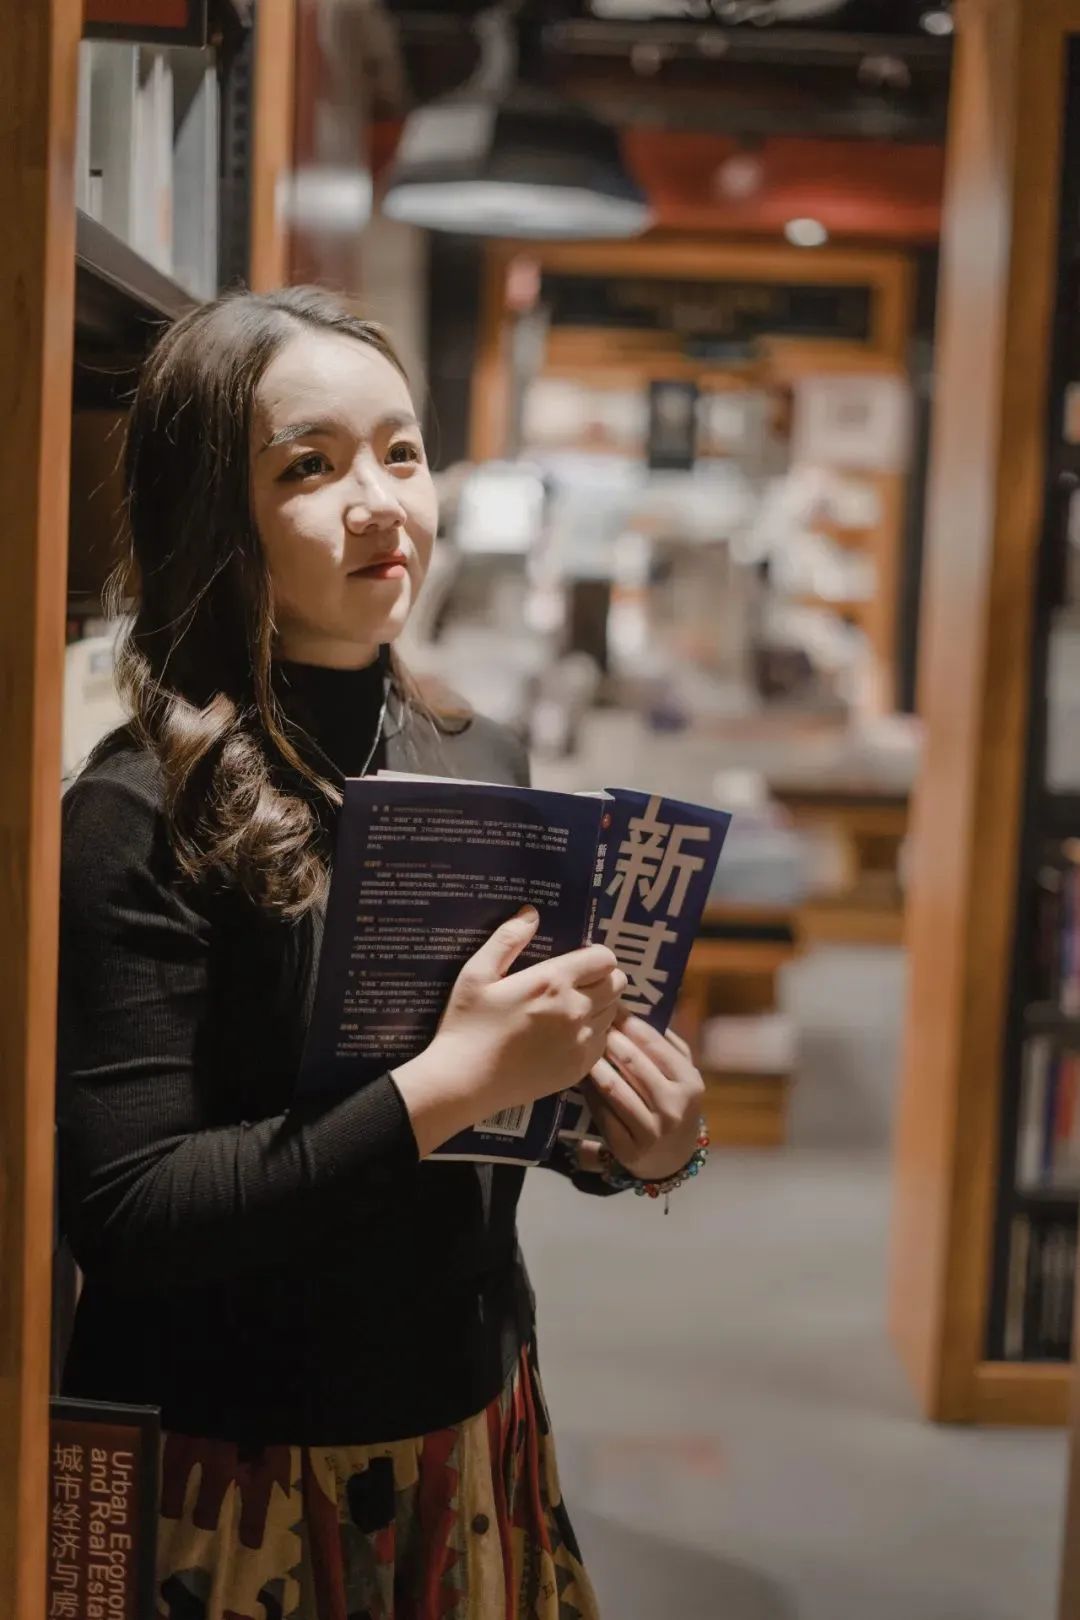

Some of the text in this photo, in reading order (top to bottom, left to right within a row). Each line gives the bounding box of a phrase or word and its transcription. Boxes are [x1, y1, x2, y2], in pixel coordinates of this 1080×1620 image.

[51, 1442, 83, 1620] 城市经济与房
[87, 1448, 113, 1620] and Real Esta
[111, 1451, 133, 1525] Urban
